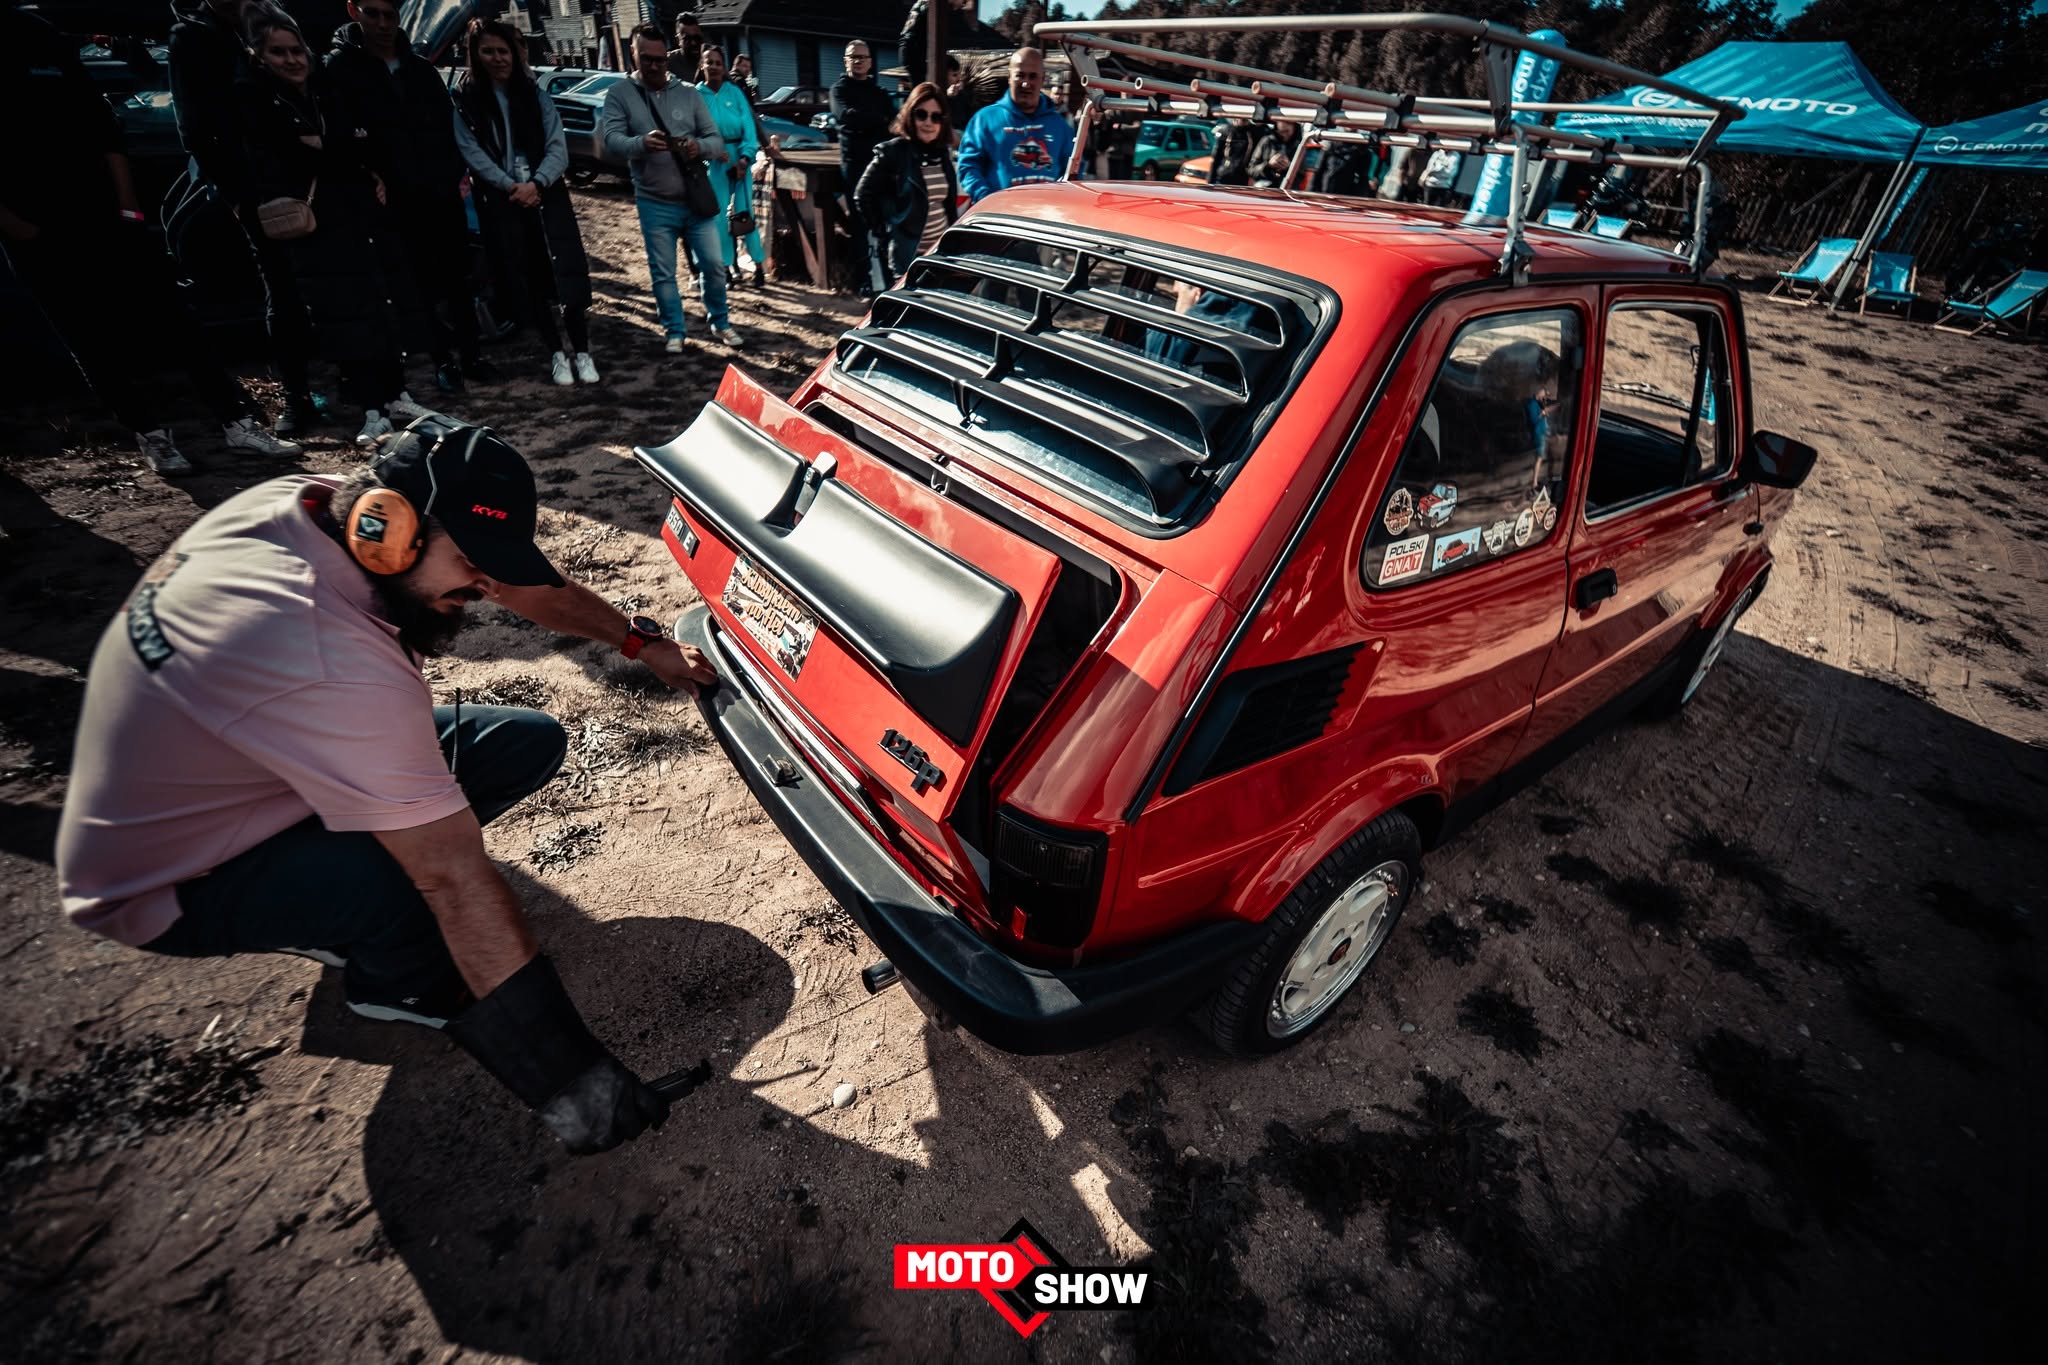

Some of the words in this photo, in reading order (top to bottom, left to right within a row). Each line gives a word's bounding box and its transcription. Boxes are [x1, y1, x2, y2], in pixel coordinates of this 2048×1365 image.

[1684, 95, 1857, 116] MOTO
[1960, 142, 2045, 152] CFMOTO
[683, 530, 695, 551] E
[1389, 539, 1425, 558] POLSKI
[1384, 553, 1421, 578] GNAT
